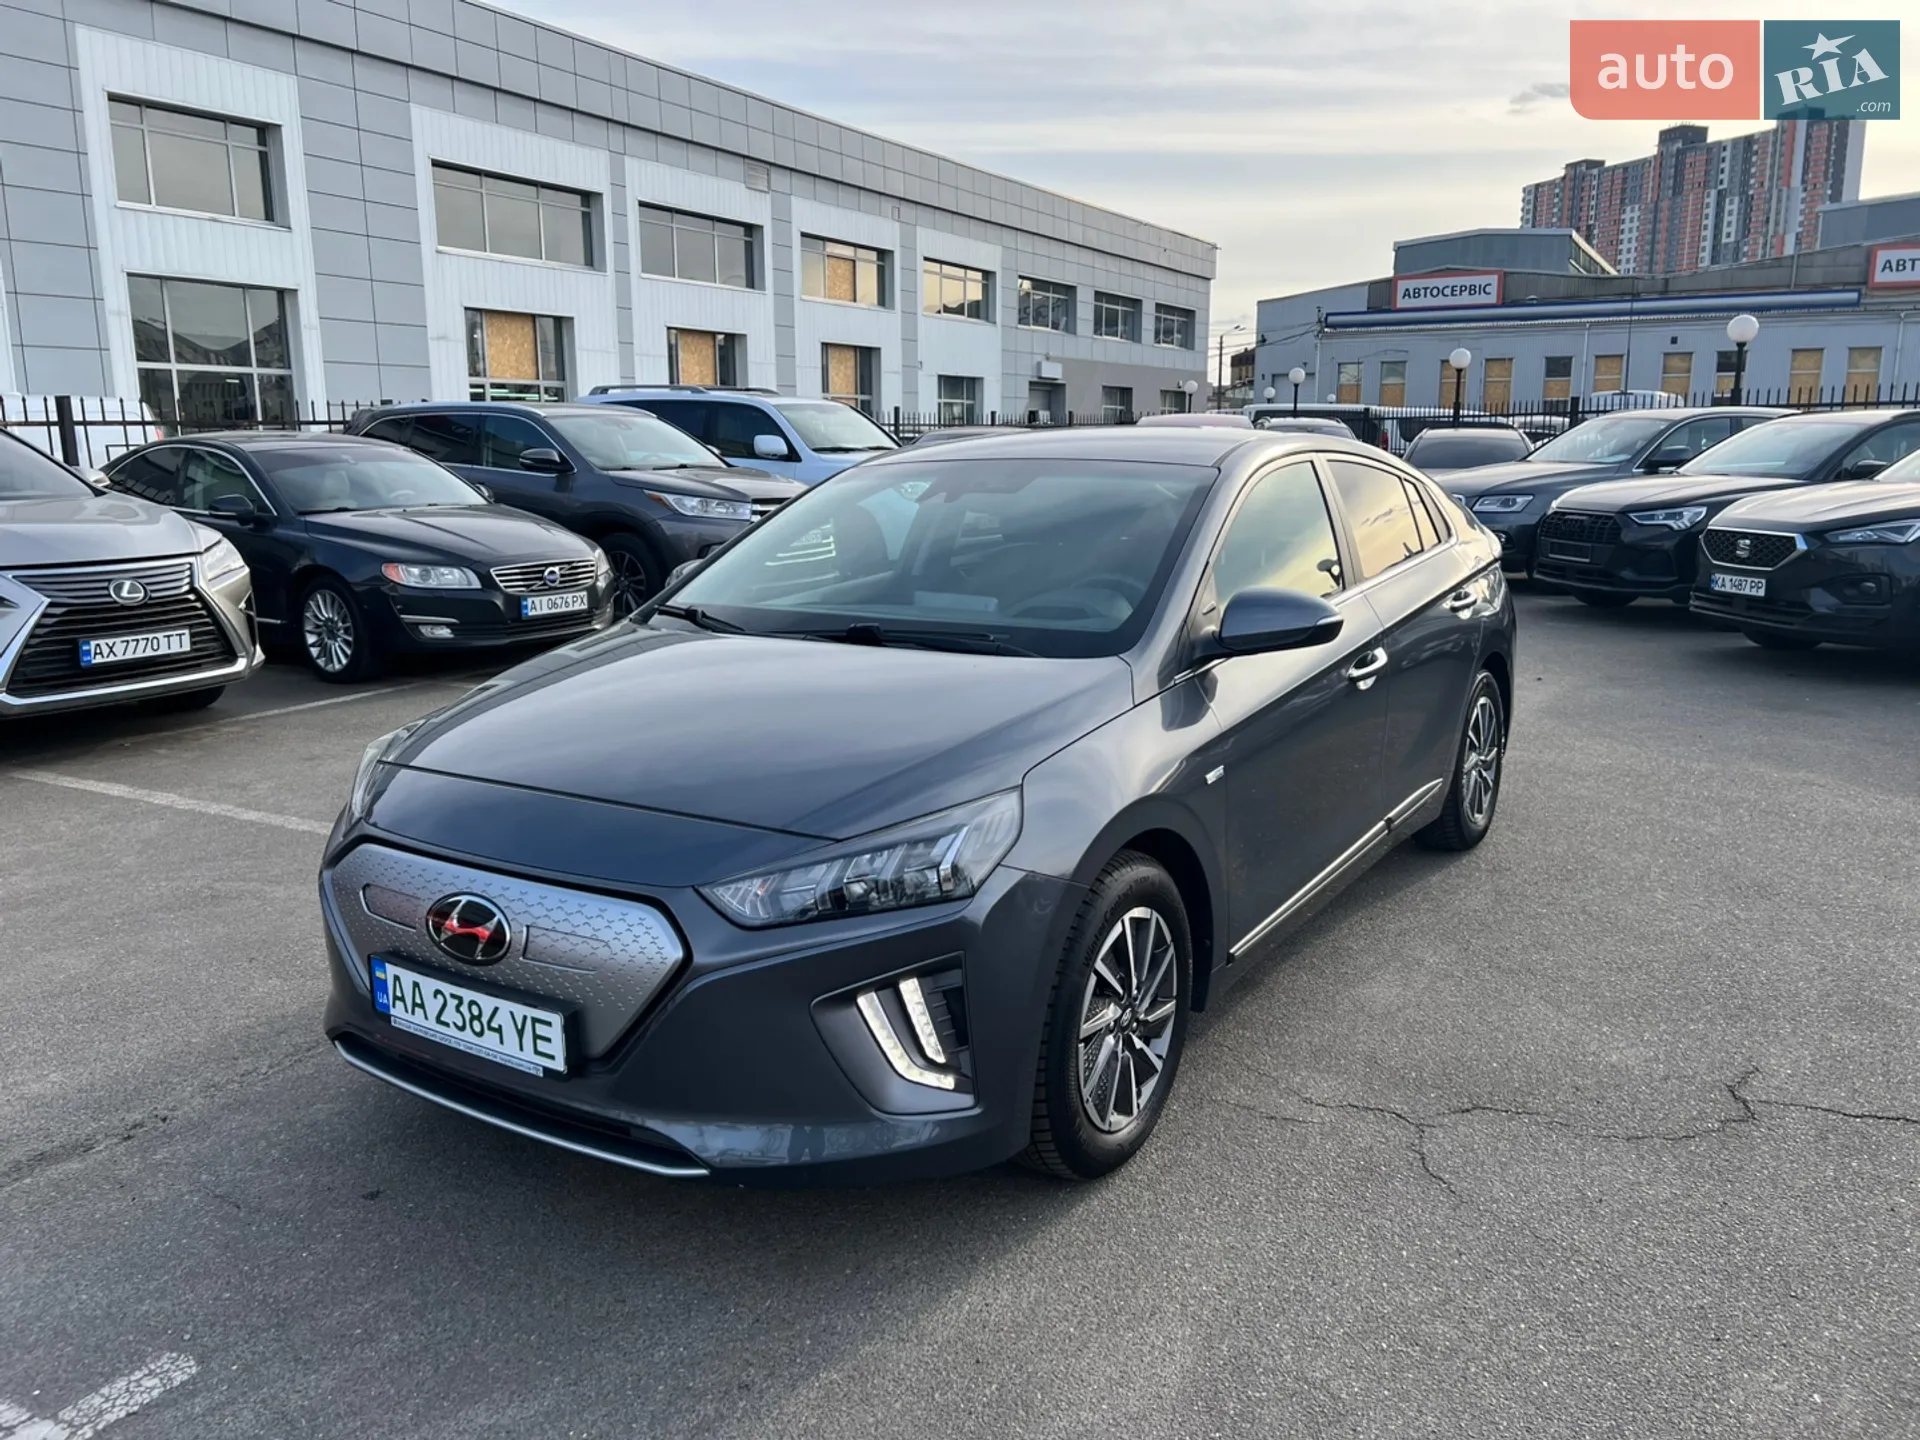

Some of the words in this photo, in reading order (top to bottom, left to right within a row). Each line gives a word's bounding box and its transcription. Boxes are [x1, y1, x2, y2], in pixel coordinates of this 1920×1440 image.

[1401, 282, 1493, 300] АВТОСЕРВІС
[1715, 576, 1727, 590] KA
[1729, 577, 1748, 592] 1487
[1749, 579, 1764, 594] PP
[529, 599, 543, 613] AI
[546, 595, 571, 611] 0676
[571, 594, 587, 608] PX
[93, 641, 118, 660] AX
[120, 635, 160, 657] 7770
[163, 632, 187, 651] TT
[376, 991, 389, 1005] UA
[391, 973, 429, 1022] AA
[433, 988, 505, 1046] 2384
[509, 1010, 556, 1062] YE
